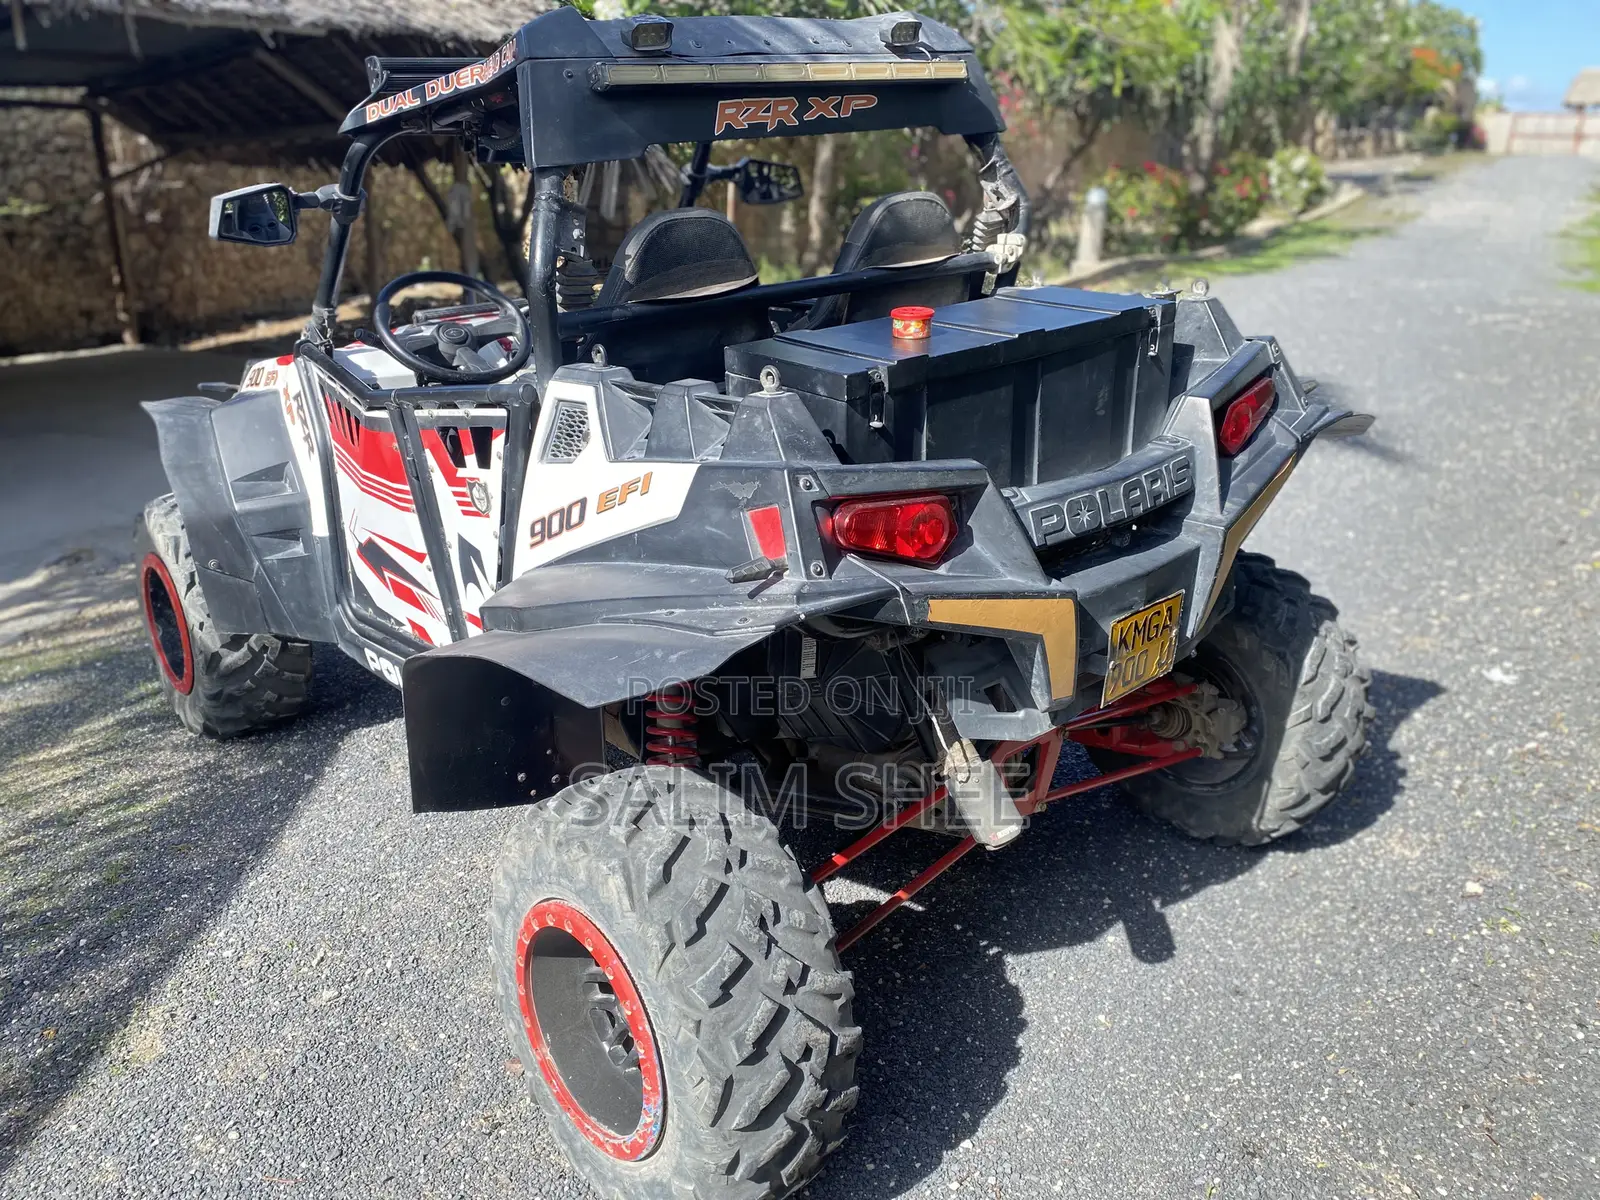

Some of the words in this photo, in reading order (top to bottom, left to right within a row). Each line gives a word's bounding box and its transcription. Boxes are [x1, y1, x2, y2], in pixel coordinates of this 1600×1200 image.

[366, 89, 420, 123] DUAL
[715, 97, 799, 136] RZR
[803, 94, 878, 121] XP
[264, 370, 279, 387] EFI
[529, 496, 587, 550] 900
[596, 471, 653, 514] EFI
[1028, 455, 1193, 546] POLARIS
[1117, 605, 1173, 652] KMGA
